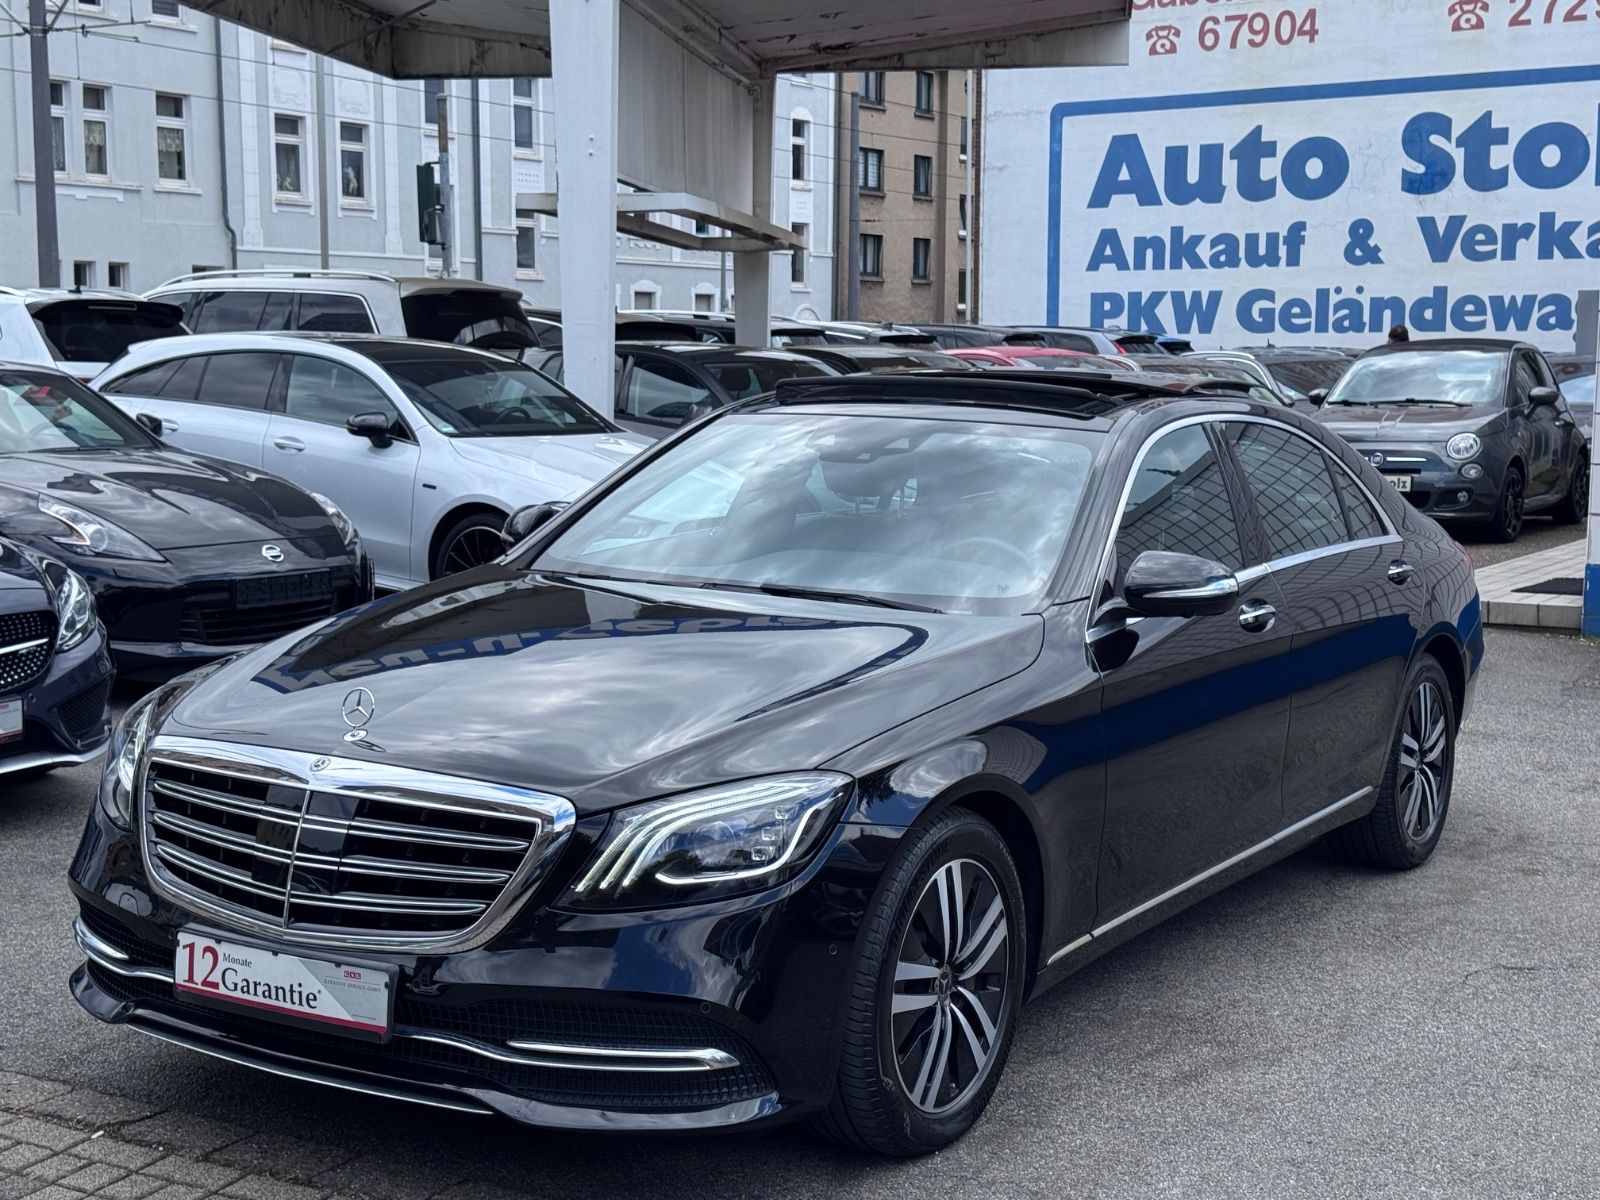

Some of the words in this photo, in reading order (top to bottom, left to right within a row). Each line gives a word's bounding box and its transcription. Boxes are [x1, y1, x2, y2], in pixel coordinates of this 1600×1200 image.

[1198, 8, 1319, 52] 67904
[1508, 0, 1600, 27] 272
[1086, 124, 1350, 209] Auto
[1401, 109, 1600, 196] Sto
[1085, 221, 1307, 272] Ankauf
[1343, 218, 1385, 266] &
[1090, 290, 1223, 334] PKW
[1236, 285, 1578, 343] Geländewa
[182, 942, 220, 990] 12
[222, 952, 252, 968] Monate
